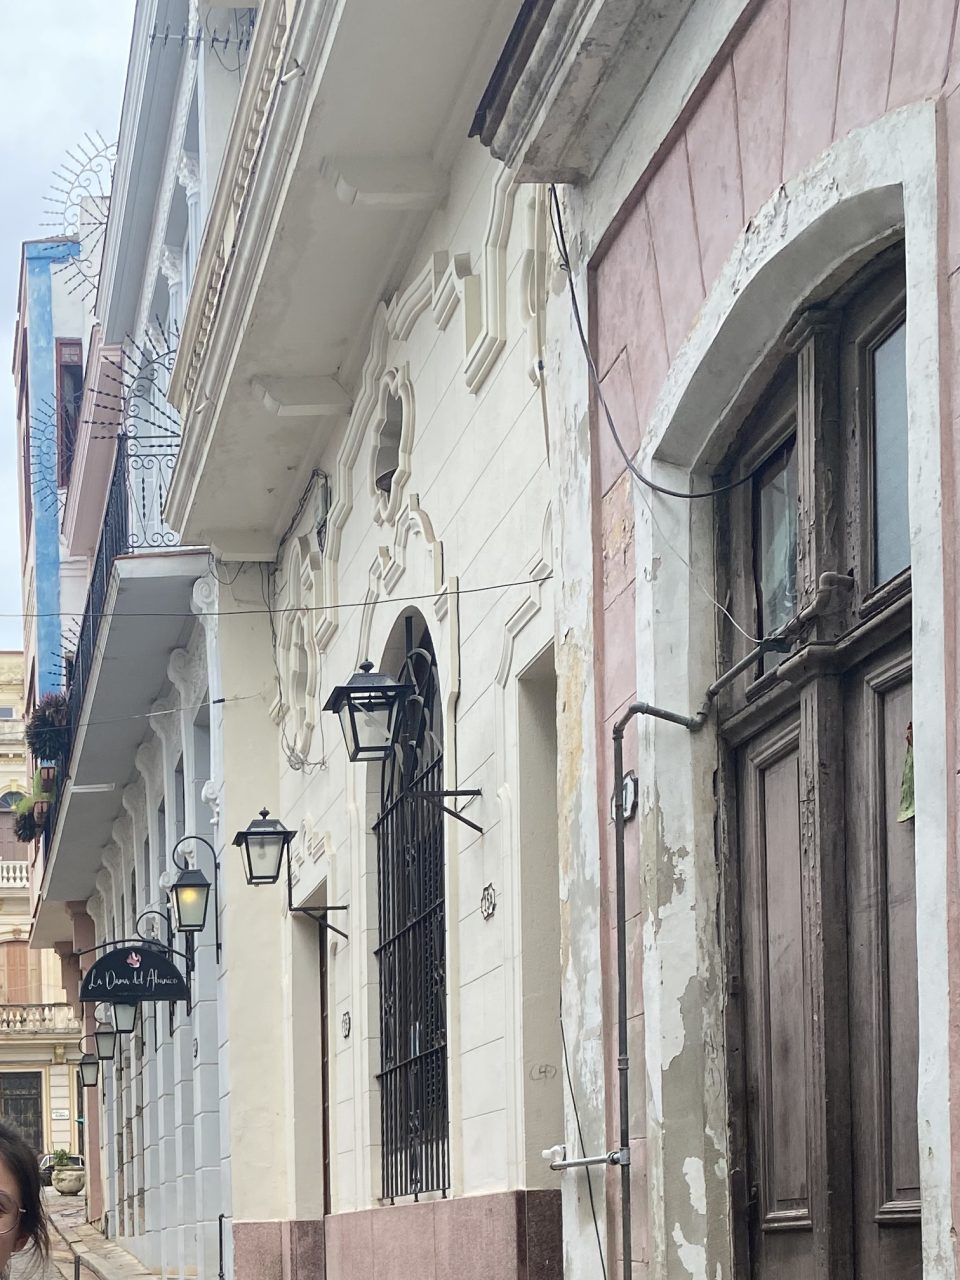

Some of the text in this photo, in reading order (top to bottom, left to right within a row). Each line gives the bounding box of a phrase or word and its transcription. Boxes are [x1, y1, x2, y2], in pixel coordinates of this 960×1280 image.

[88, 968, 178, 991] La Dama del Abanico
